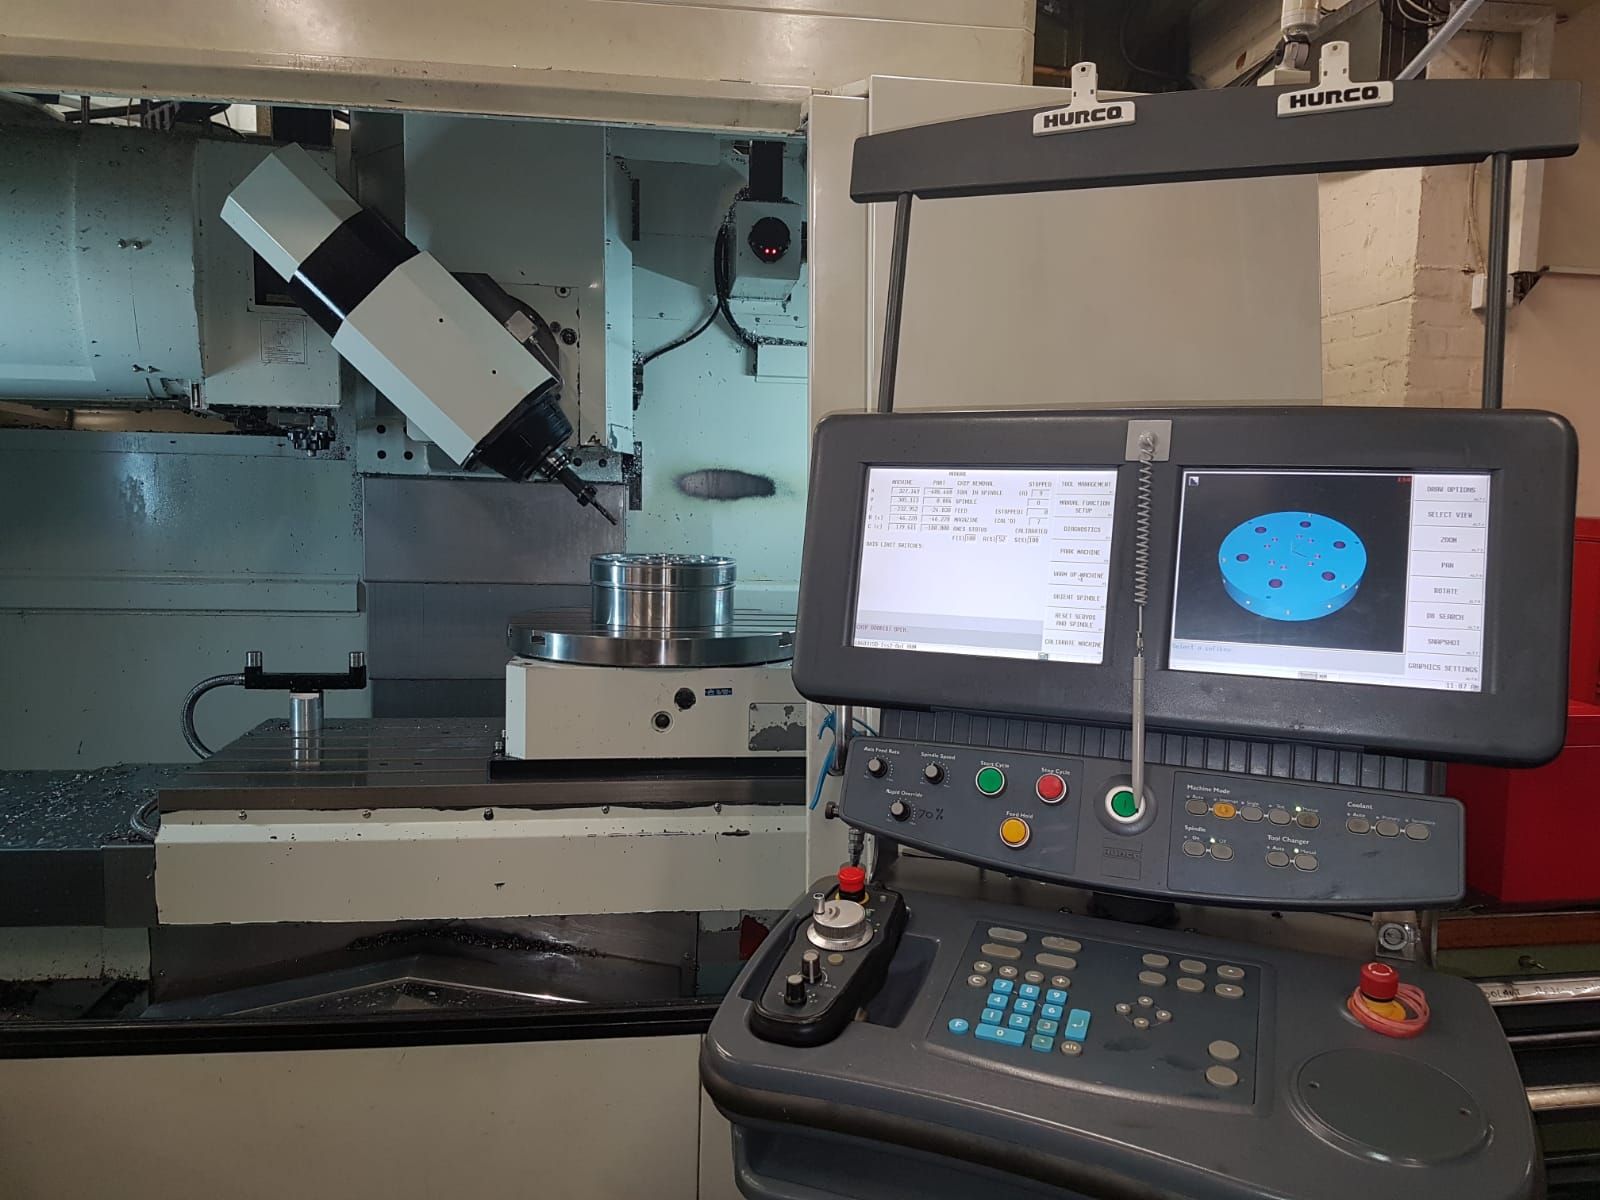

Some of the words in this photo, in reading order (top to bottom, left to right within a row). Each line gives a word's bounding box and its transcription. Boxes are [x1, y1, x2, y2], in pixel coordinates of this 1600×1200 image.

[1290, 86, 1379, 109] HURCO
[1043, 106, 1122, 128] HURCO
[1447, 486, 1476, 494] OPTIONS
[1427, 638, 1460, 646] SNAPSHOT
[1408, 663, 1441, 671] GRAPHICS
[1444, 665, 1478, 673] SETTINGS
[1187, 784, 1212, 792] Machine
[901, 790, 923, 798] Override
[1347, 801, 1373, 810] Coolant
[1184, 825, 1206, 833] Spindle
[1282, 837, 1310, 845] Changer
[1015, 1016, 1023, 1024] 2
[996, 1029, 1004, 1037] 0
